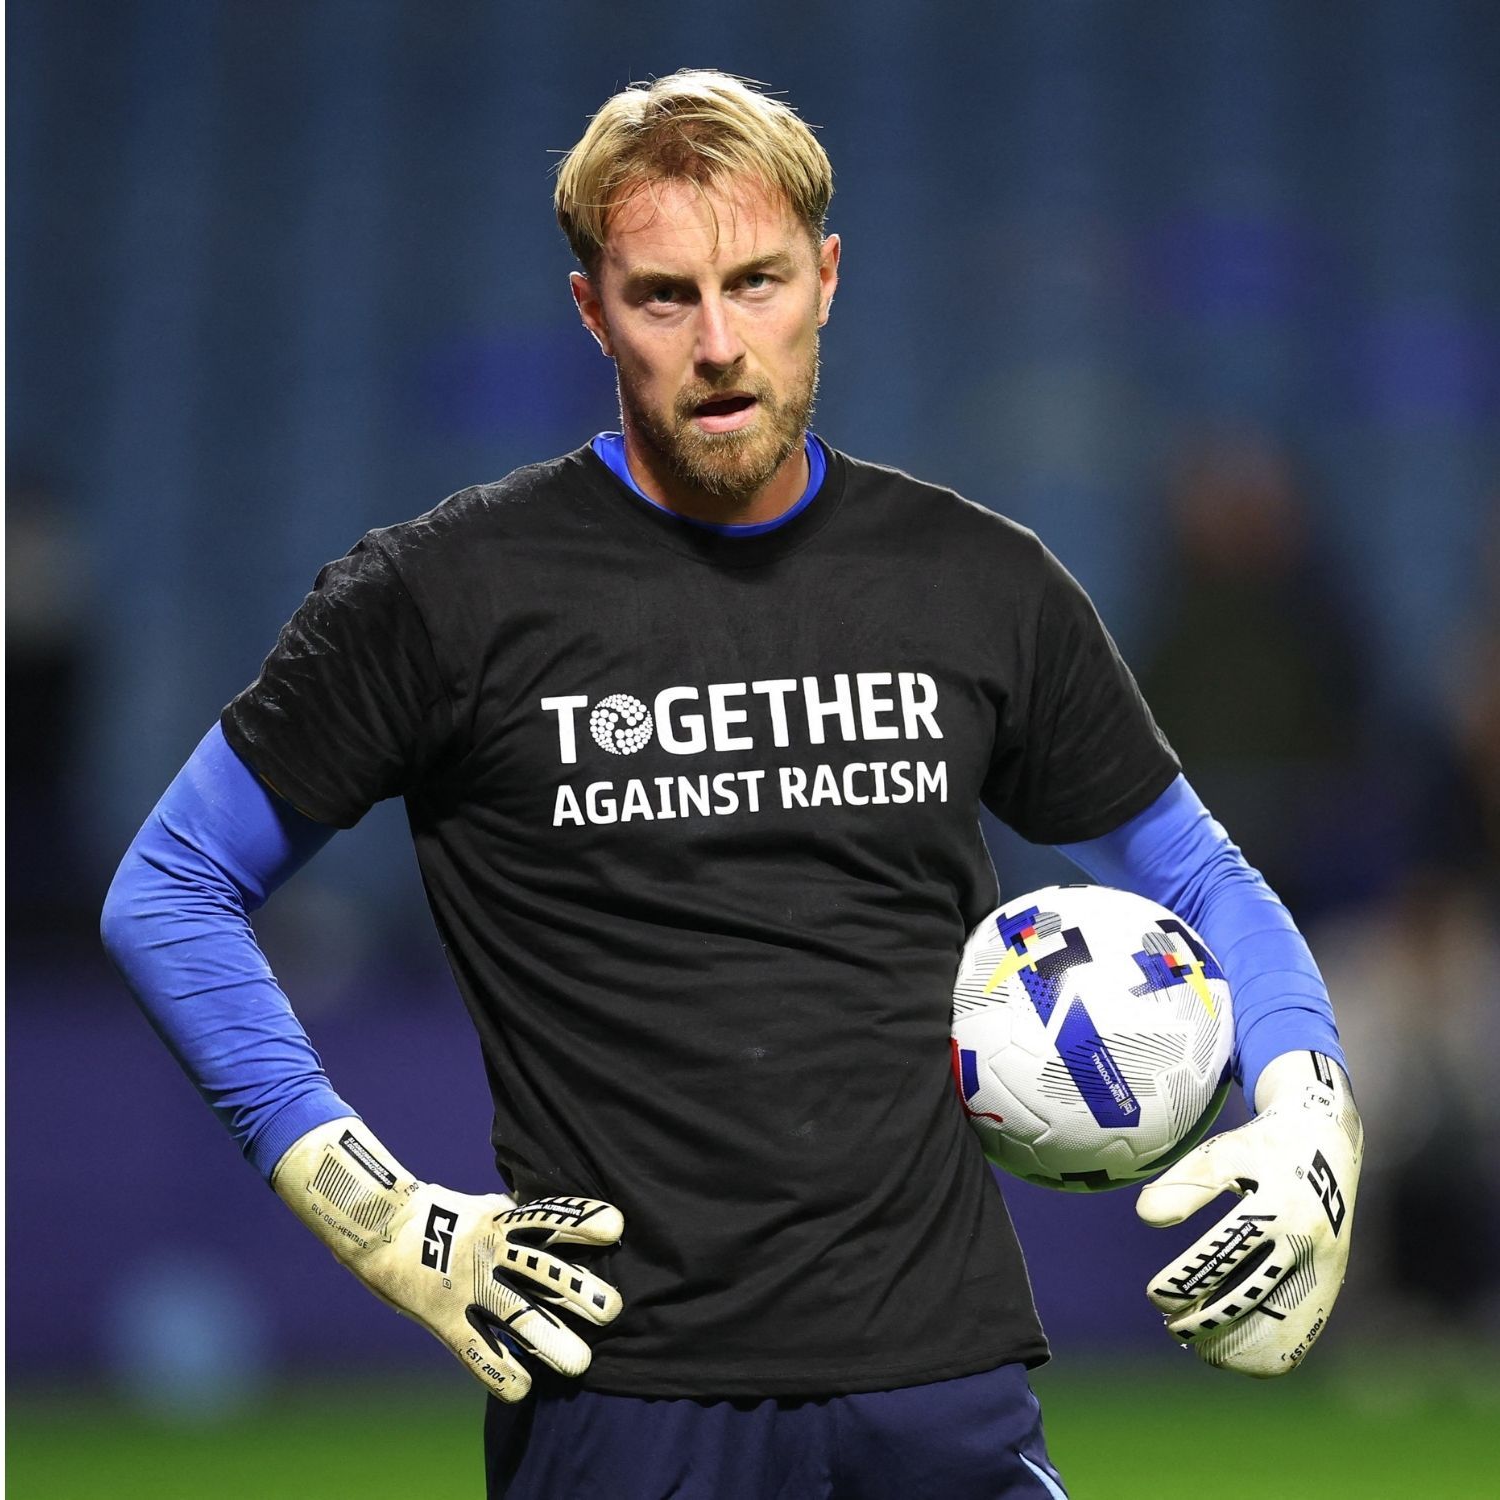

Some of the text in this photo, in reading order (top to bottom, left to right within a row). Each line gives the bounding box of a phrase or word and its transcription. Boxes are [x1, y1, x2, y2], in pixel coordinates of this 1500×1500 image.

[553, 760, 948, 826] AGAINST RACISM
[1090, 1052, 1112, 1085] FOOTBALL
[543, 1203, 581, 1215] ALTERNATIVE
[1182, 1223, 1253, 1290] THE ORIGINAL ALTERNATIVE
[1290, 1317, 1324, 1362] EST. 2004
[466, 1347, 506, 1384] EST. 2004
